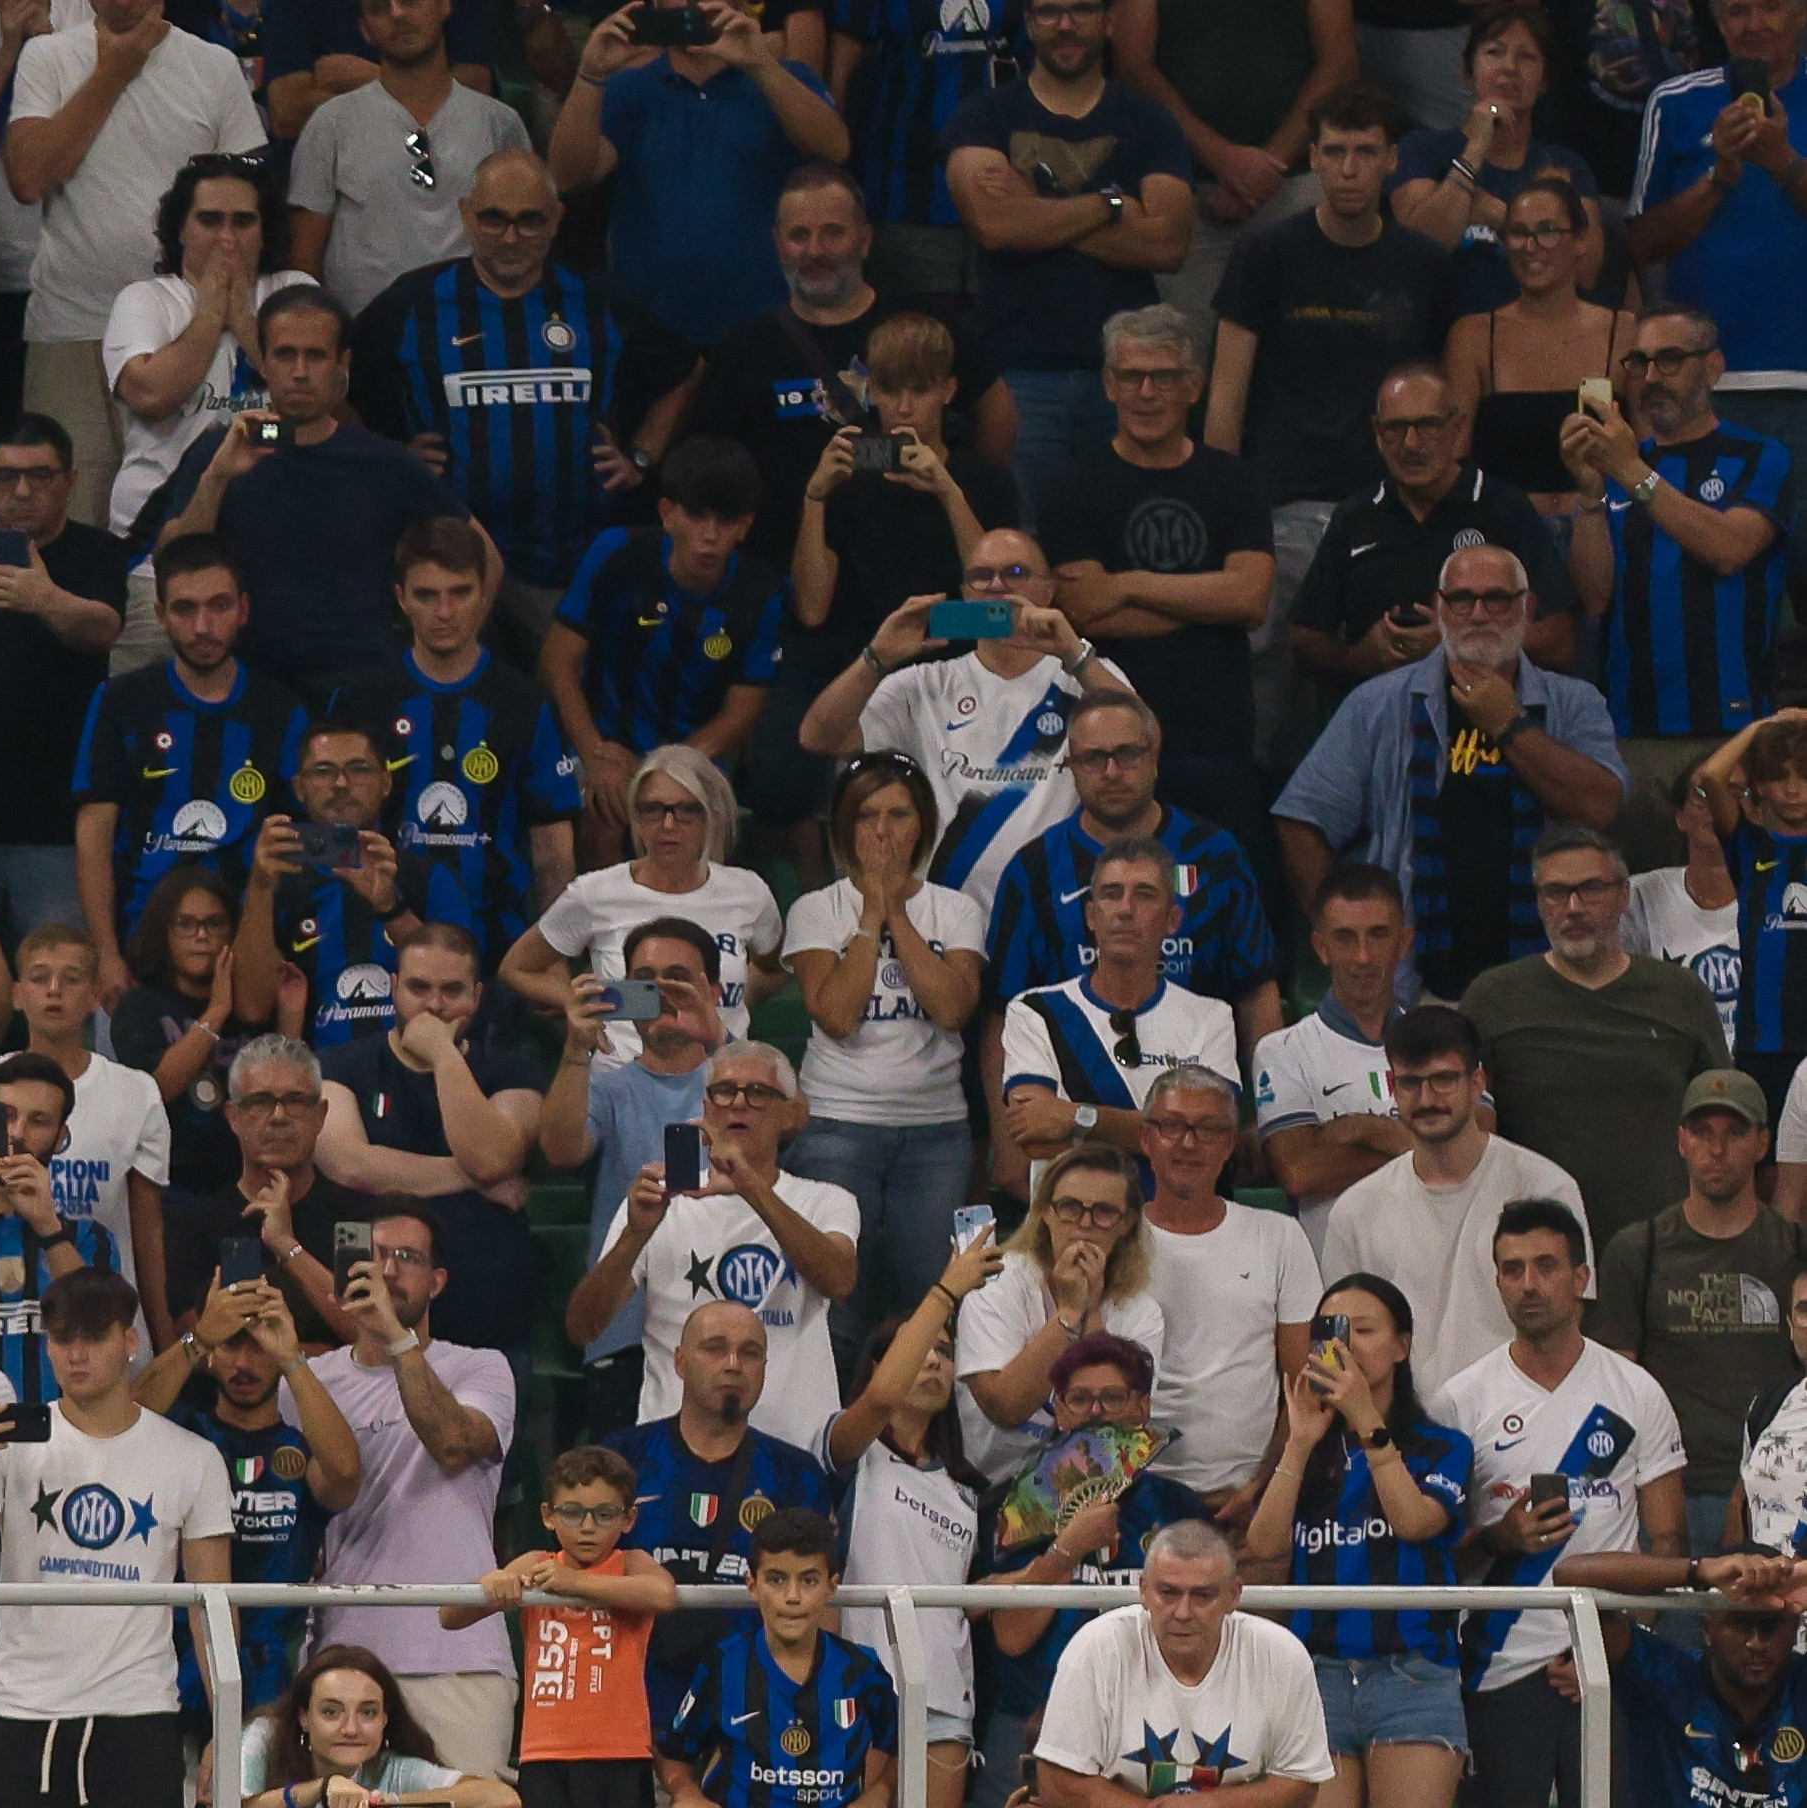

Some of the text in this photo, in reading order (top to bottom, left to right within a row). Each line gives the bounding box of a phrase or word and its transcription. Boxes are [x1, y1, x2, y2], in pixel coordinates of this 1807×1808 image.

[442, 368, 592, 407] PIRELLI
[894, 1486, 976, 1546] betsson
[749, 1763, 844, 1786] betsson
[795, 1785, 843, 1804] sport
